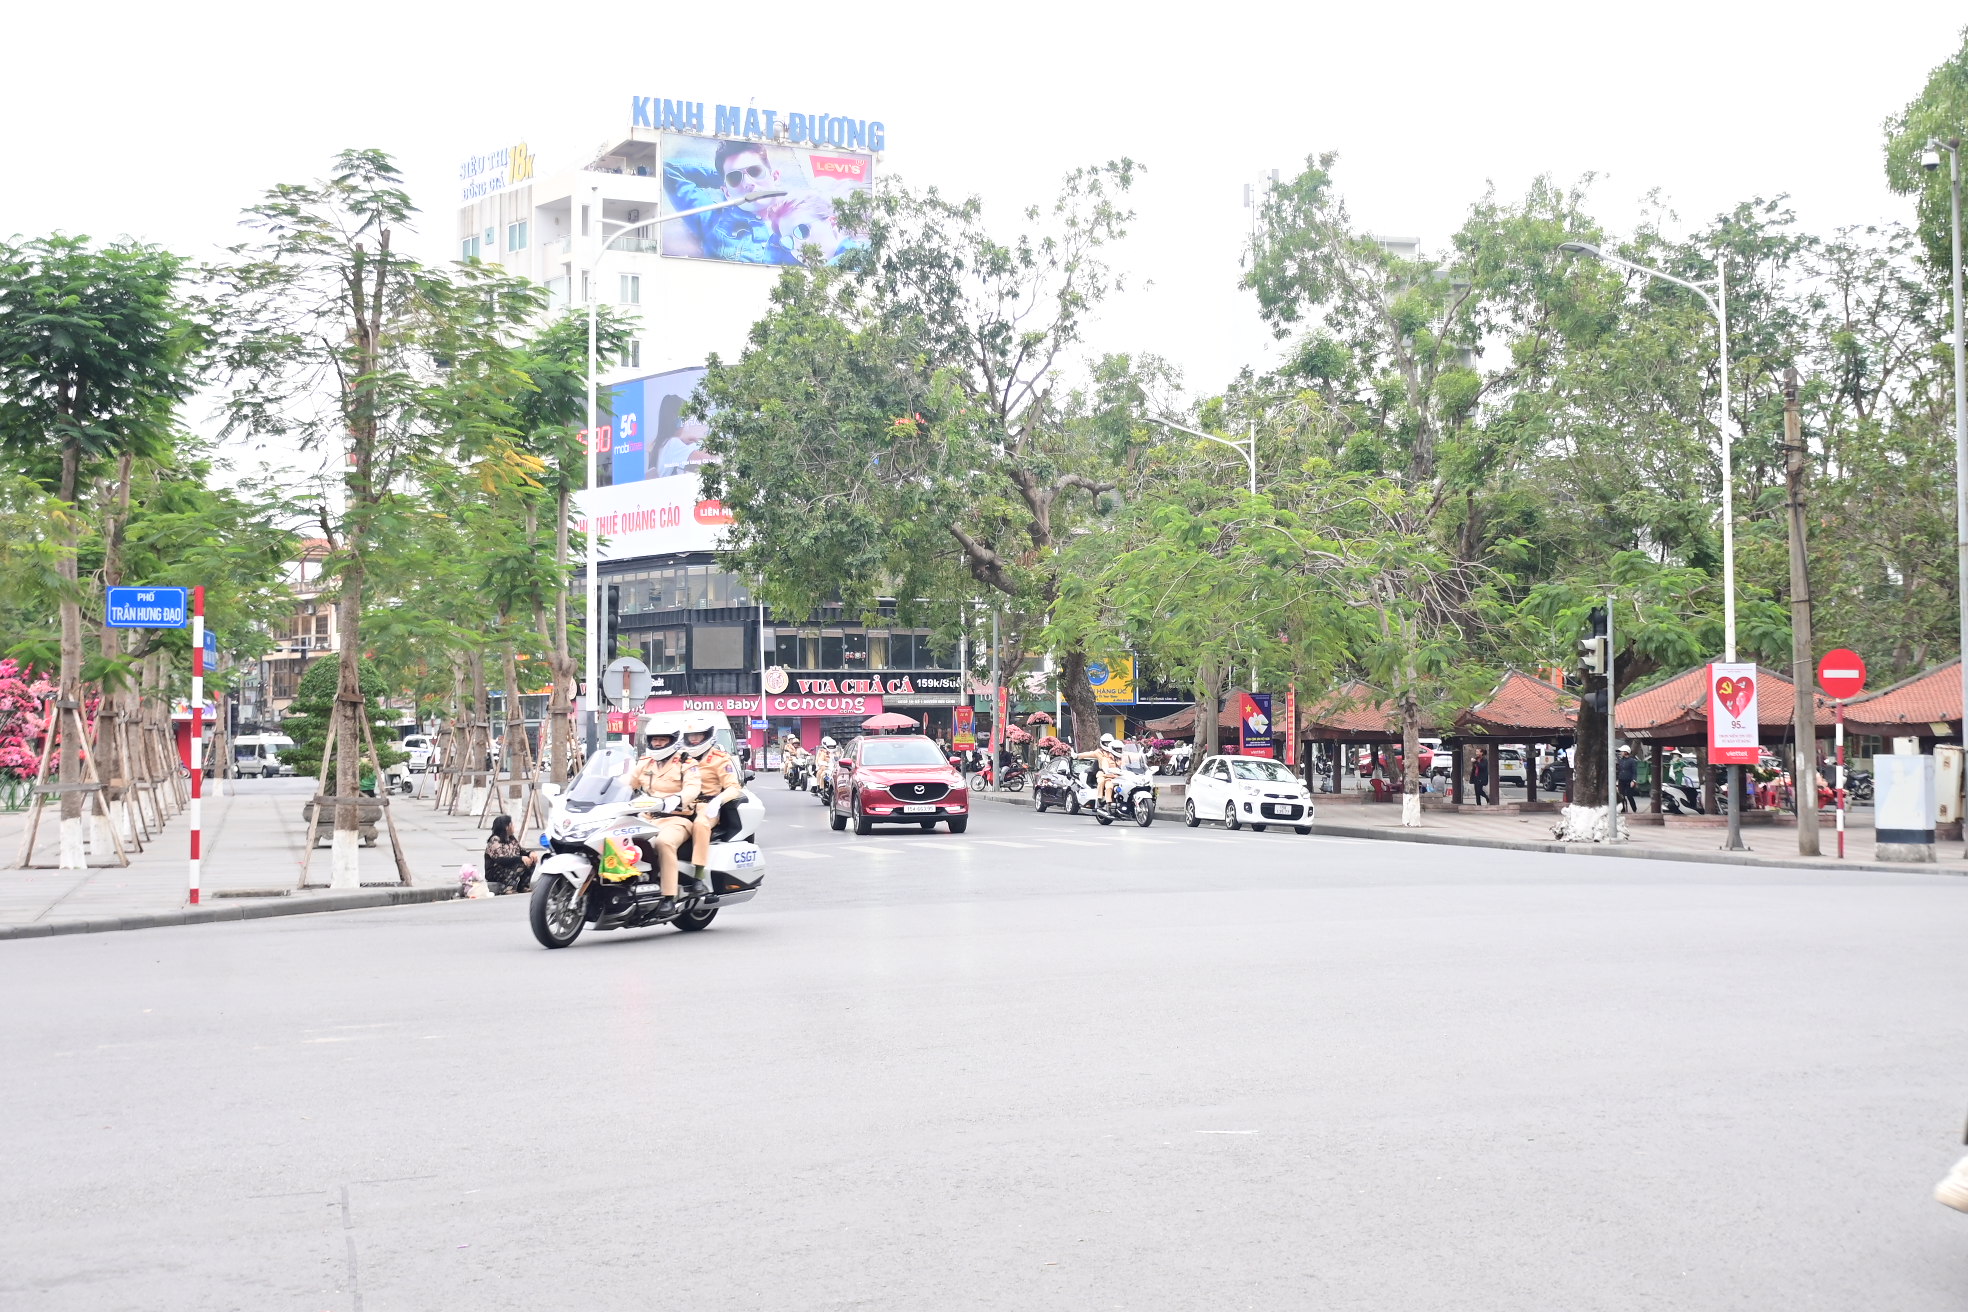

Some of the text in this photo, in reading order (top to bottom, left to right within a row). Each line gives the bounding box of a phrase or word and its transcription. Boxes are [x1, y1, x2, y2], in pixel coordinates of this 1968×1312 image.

[619, 413, 638, 438] 5G
[660, 502, 681, 528] CÁO
[137, 591, 156, 602] PHỐ
[112, 602, 181, 623] TRẦN HƯNG ĐẠO
[797, 678, 838, 694] VUA
[840, 675, 885, 694] CHẢ
[887, 675, 915, 694] CÁ
[683, 697, 760, 711] Mom & Baby
[1731, 720, 1742, 729] 95
[612, 826, 642, 836] CSGT
[733, 850, 758, 863] CSGT
